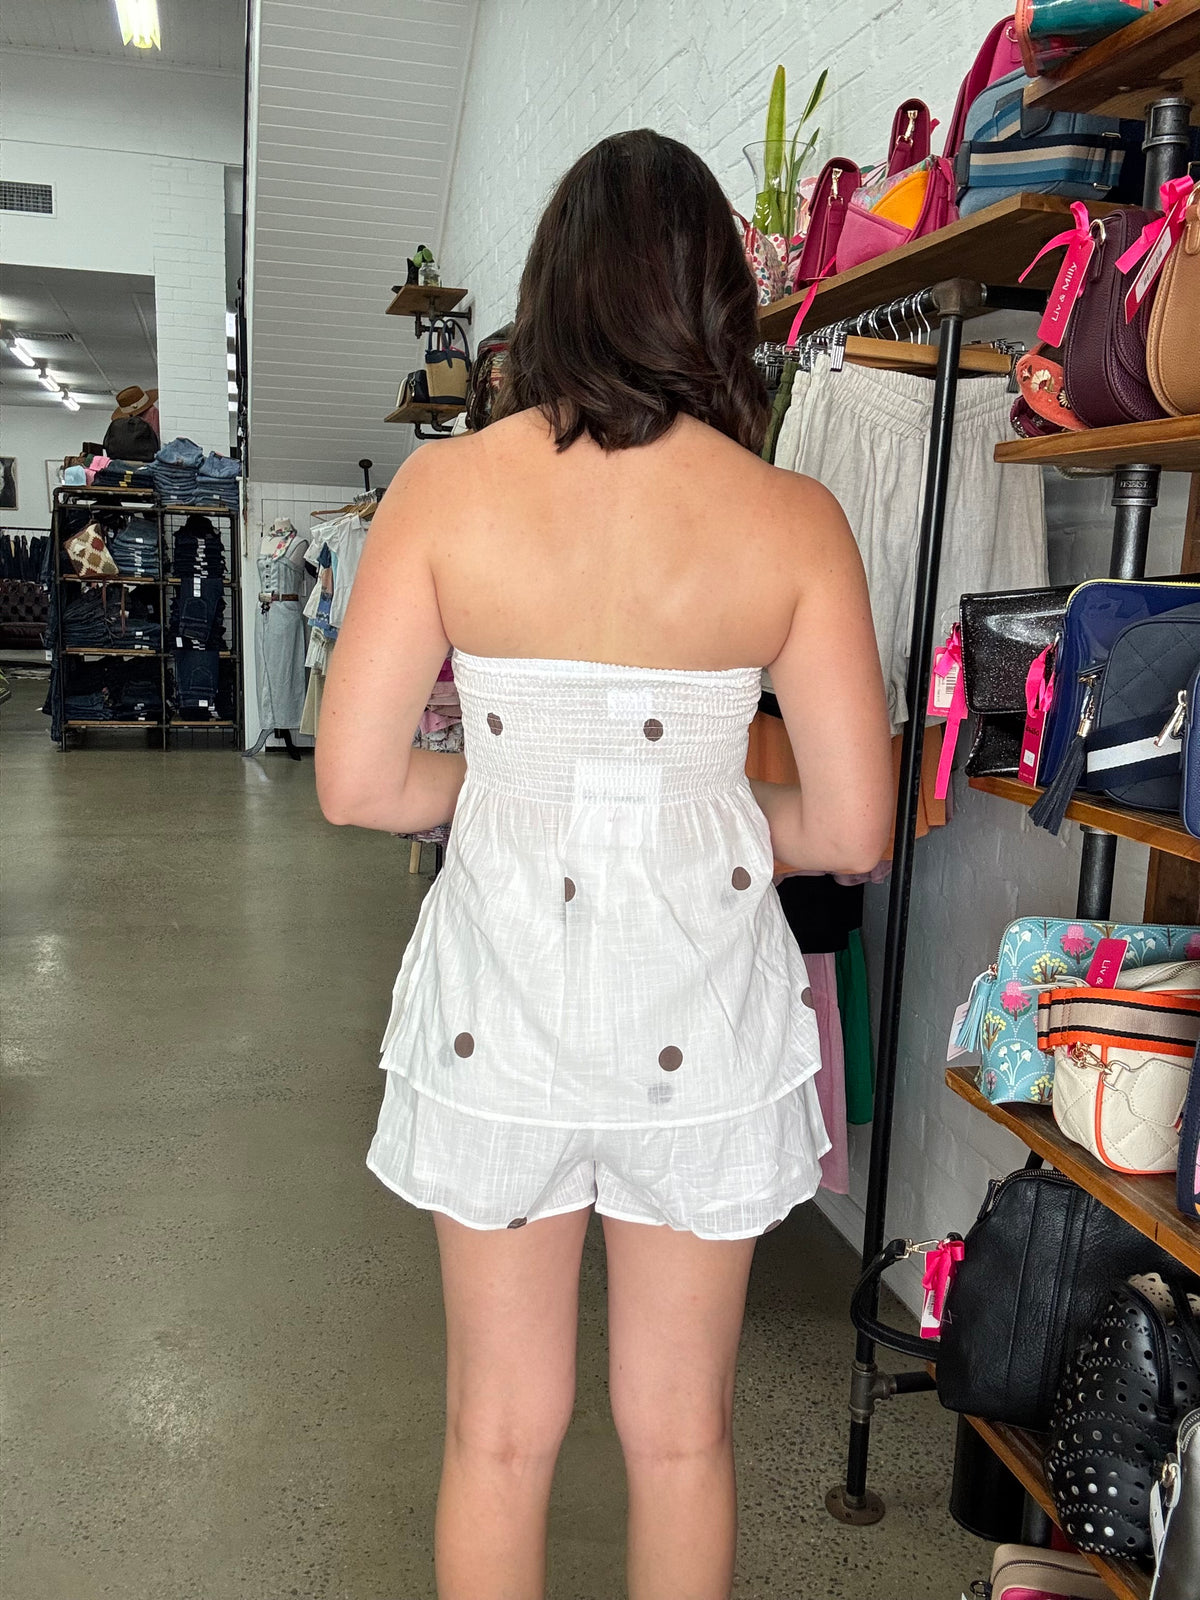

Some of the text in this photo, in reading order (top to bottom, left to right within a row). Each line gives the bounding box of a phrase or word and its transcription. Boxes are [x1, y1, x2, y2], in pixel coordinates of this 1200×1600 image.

[1051, 262, 1078, 322] Liv & Milly
[1095, 959, 1111, 985] Liv &
